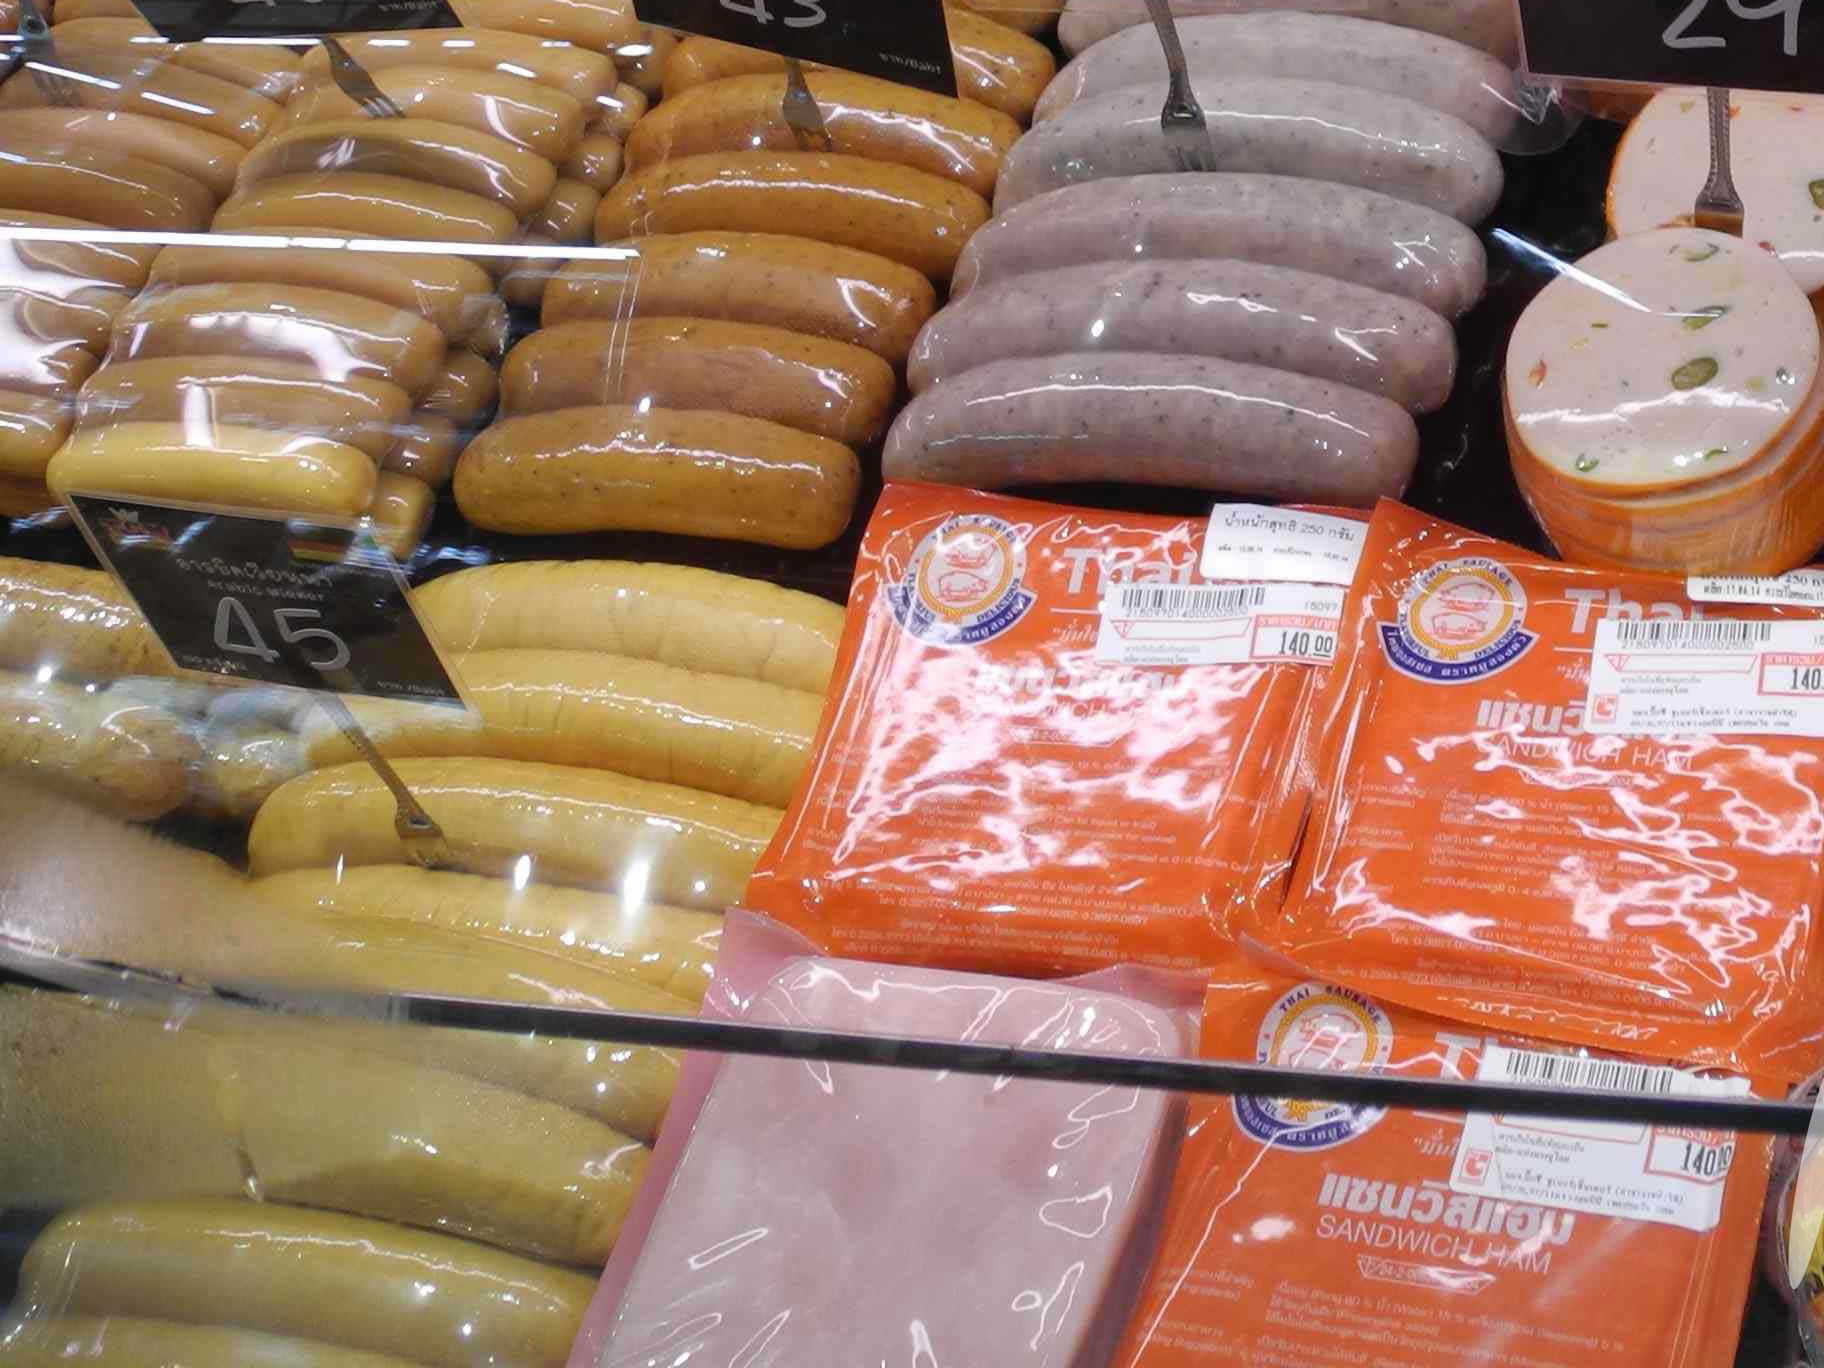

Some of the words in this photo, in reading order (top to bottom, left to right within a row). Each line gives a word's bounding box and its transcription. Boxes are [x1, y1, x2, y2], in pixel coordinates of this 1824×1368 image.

[1301, 522, 1326, 535] 250
[214, 596, 351, 671] 45
[1278, 630, 1334, 658] 140.00
[1278, 986, 1311, 1013] THAI
[1324, 984, 1382, 1023] SAUSAGE
[1315, 1212, 1473, 1260] SANDWICH
[1486, 1241, 1553, 1275] HAM
